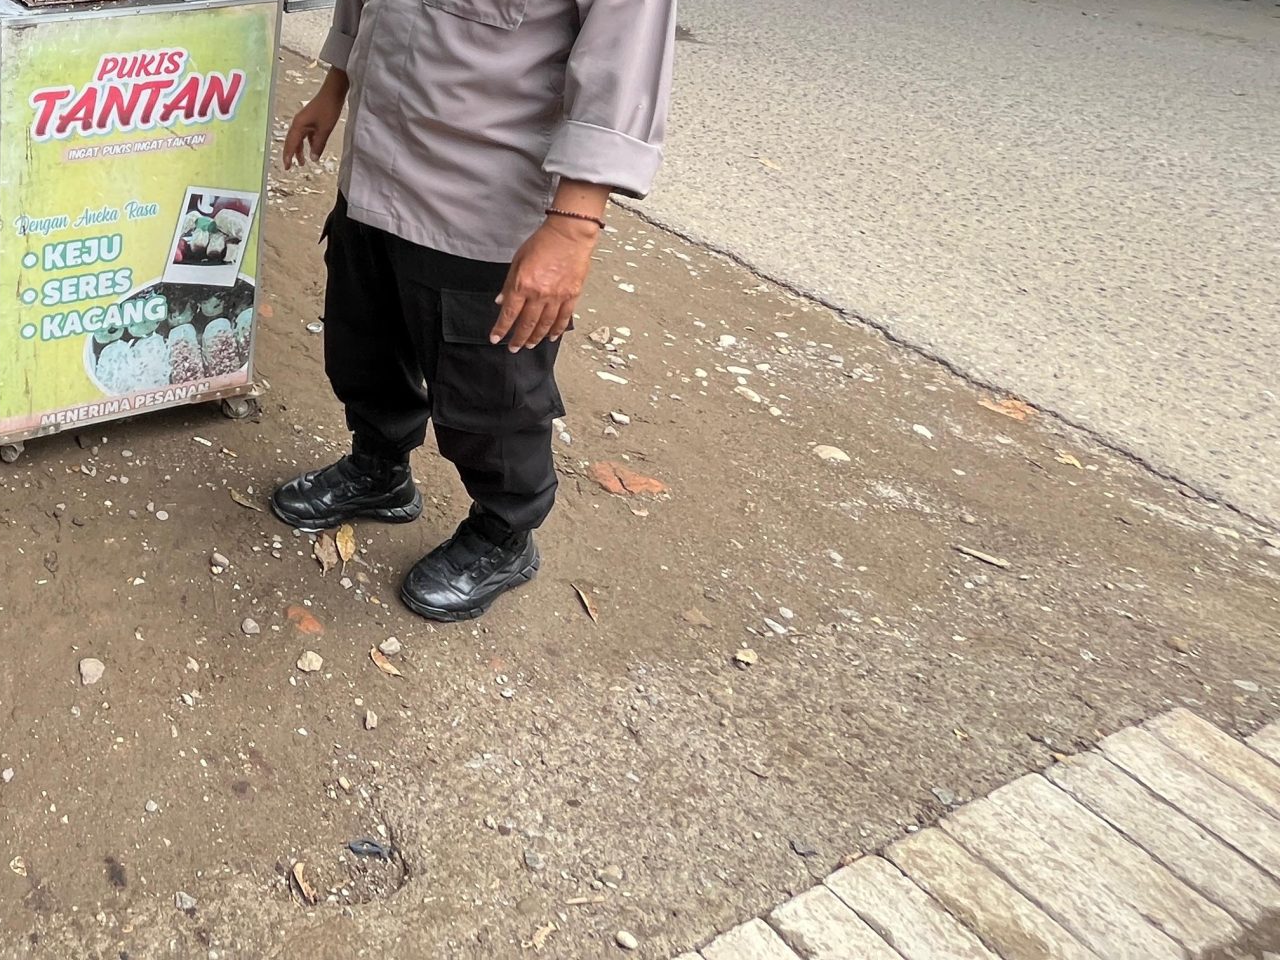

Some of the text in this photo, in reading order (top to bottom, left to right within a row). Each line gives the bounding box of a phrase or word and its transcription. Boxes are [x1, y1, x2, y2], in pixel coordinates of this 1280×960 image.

[96, 49, 185, 82] PUKIS
[32, 72, 243, 138] TANTAN
[67, 134, 206, 160] INGAT PUKIS INGAT TANTAN
[15, 199, 158, 236] Dengan Aneka Rasa
[43, 234, 122, 271] KEJU
[41, 268, 133, 306] SERES
[41, 296, 168, 340] KACANG
[39, 397, 131, 426] MENERIMA
